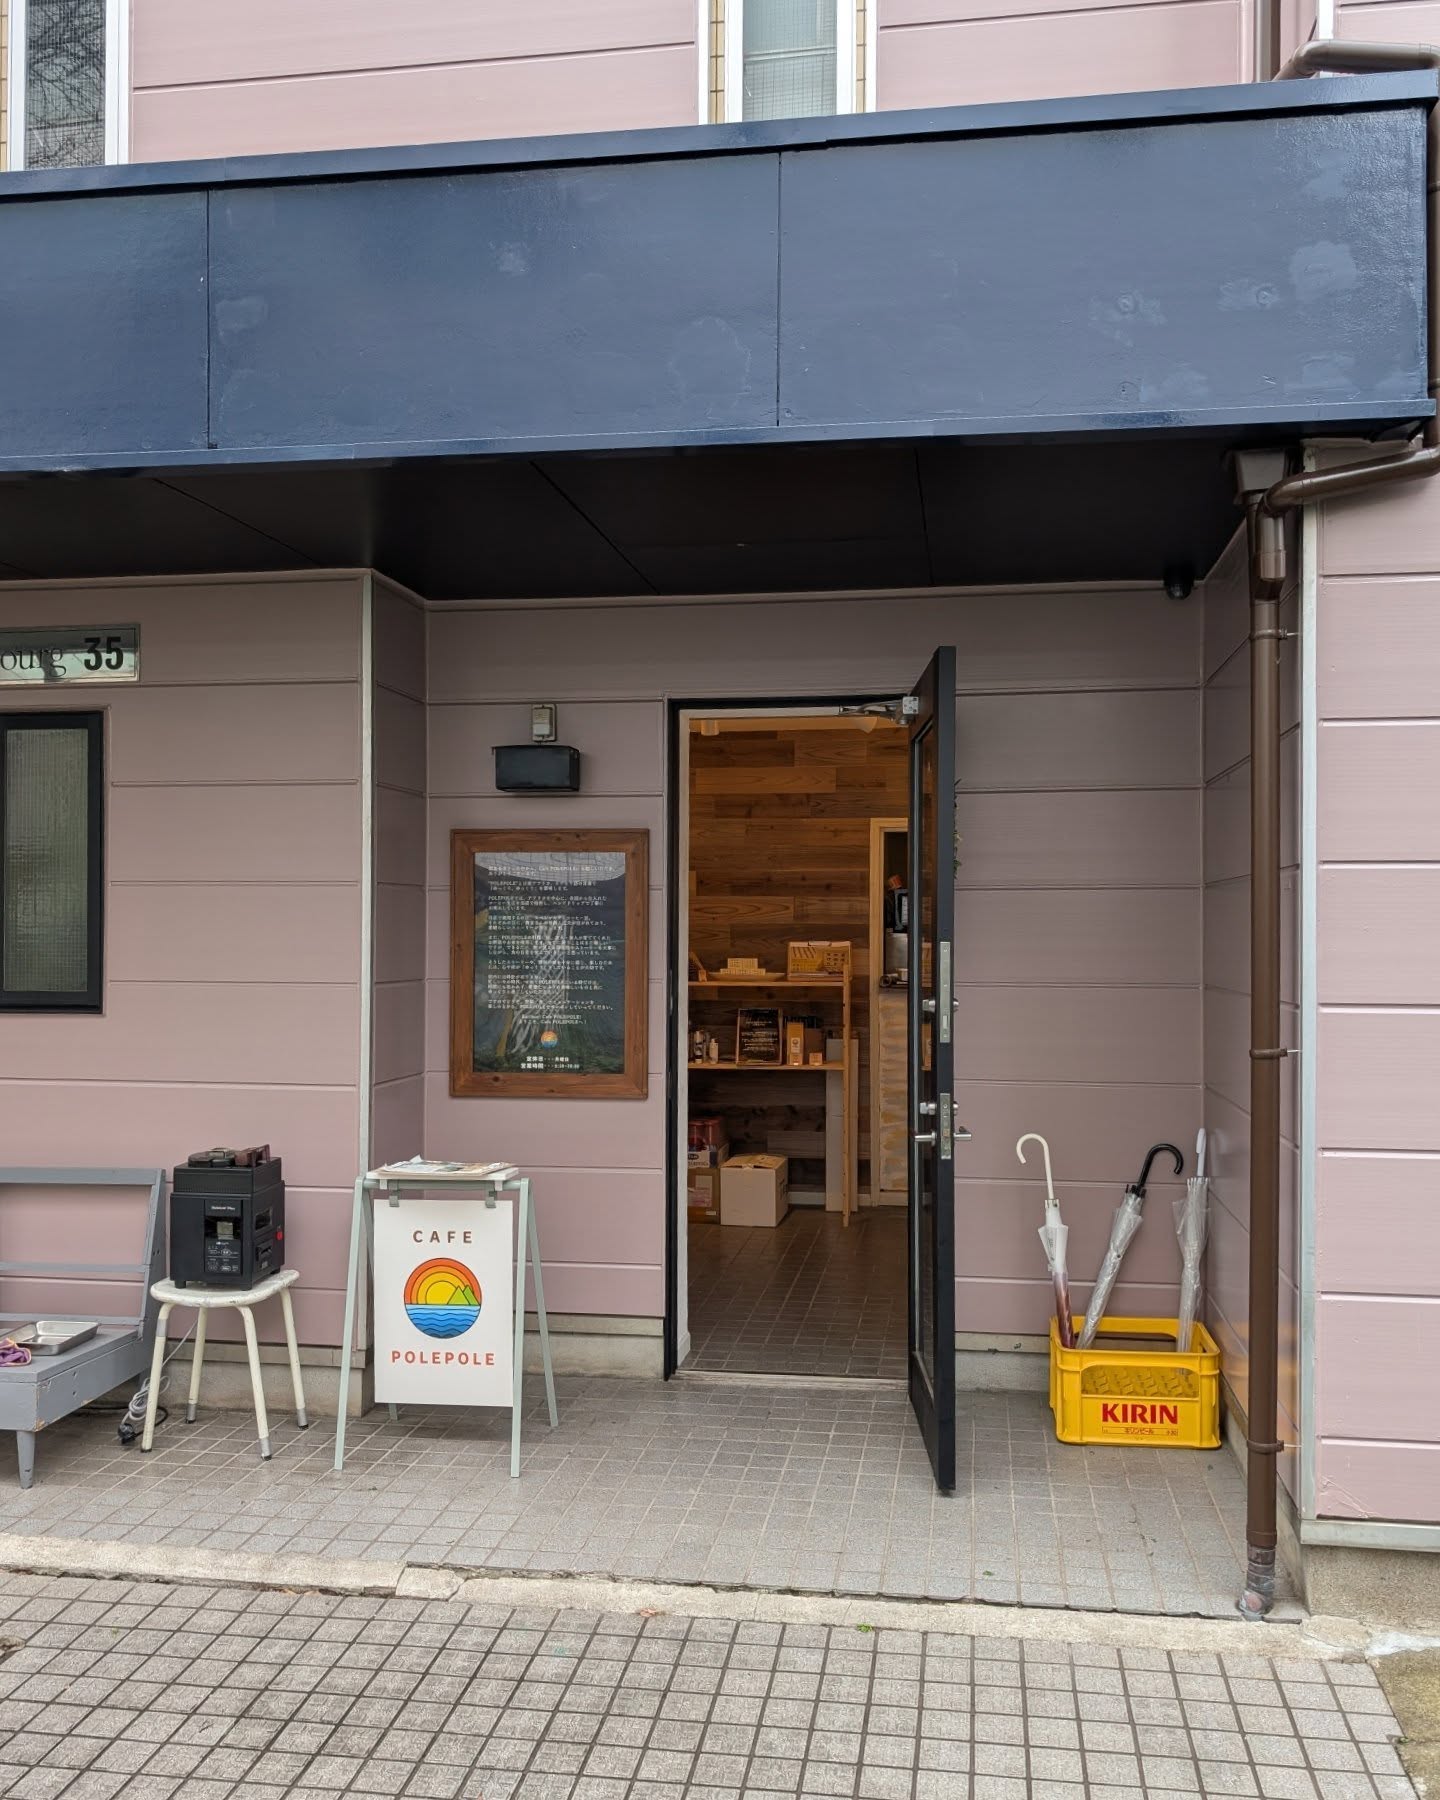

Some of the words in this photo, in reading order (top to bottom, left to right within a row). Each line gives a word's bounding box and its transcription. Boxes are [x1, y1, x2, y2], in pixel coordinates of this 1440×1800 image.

[84, 636, 124, 671] 35
[412, 1230, 472, 1243] CAFE
[391, 1350, 495, 1366] POLEPOLE
[1102, 1403, 1178, 1424] KIRIN
